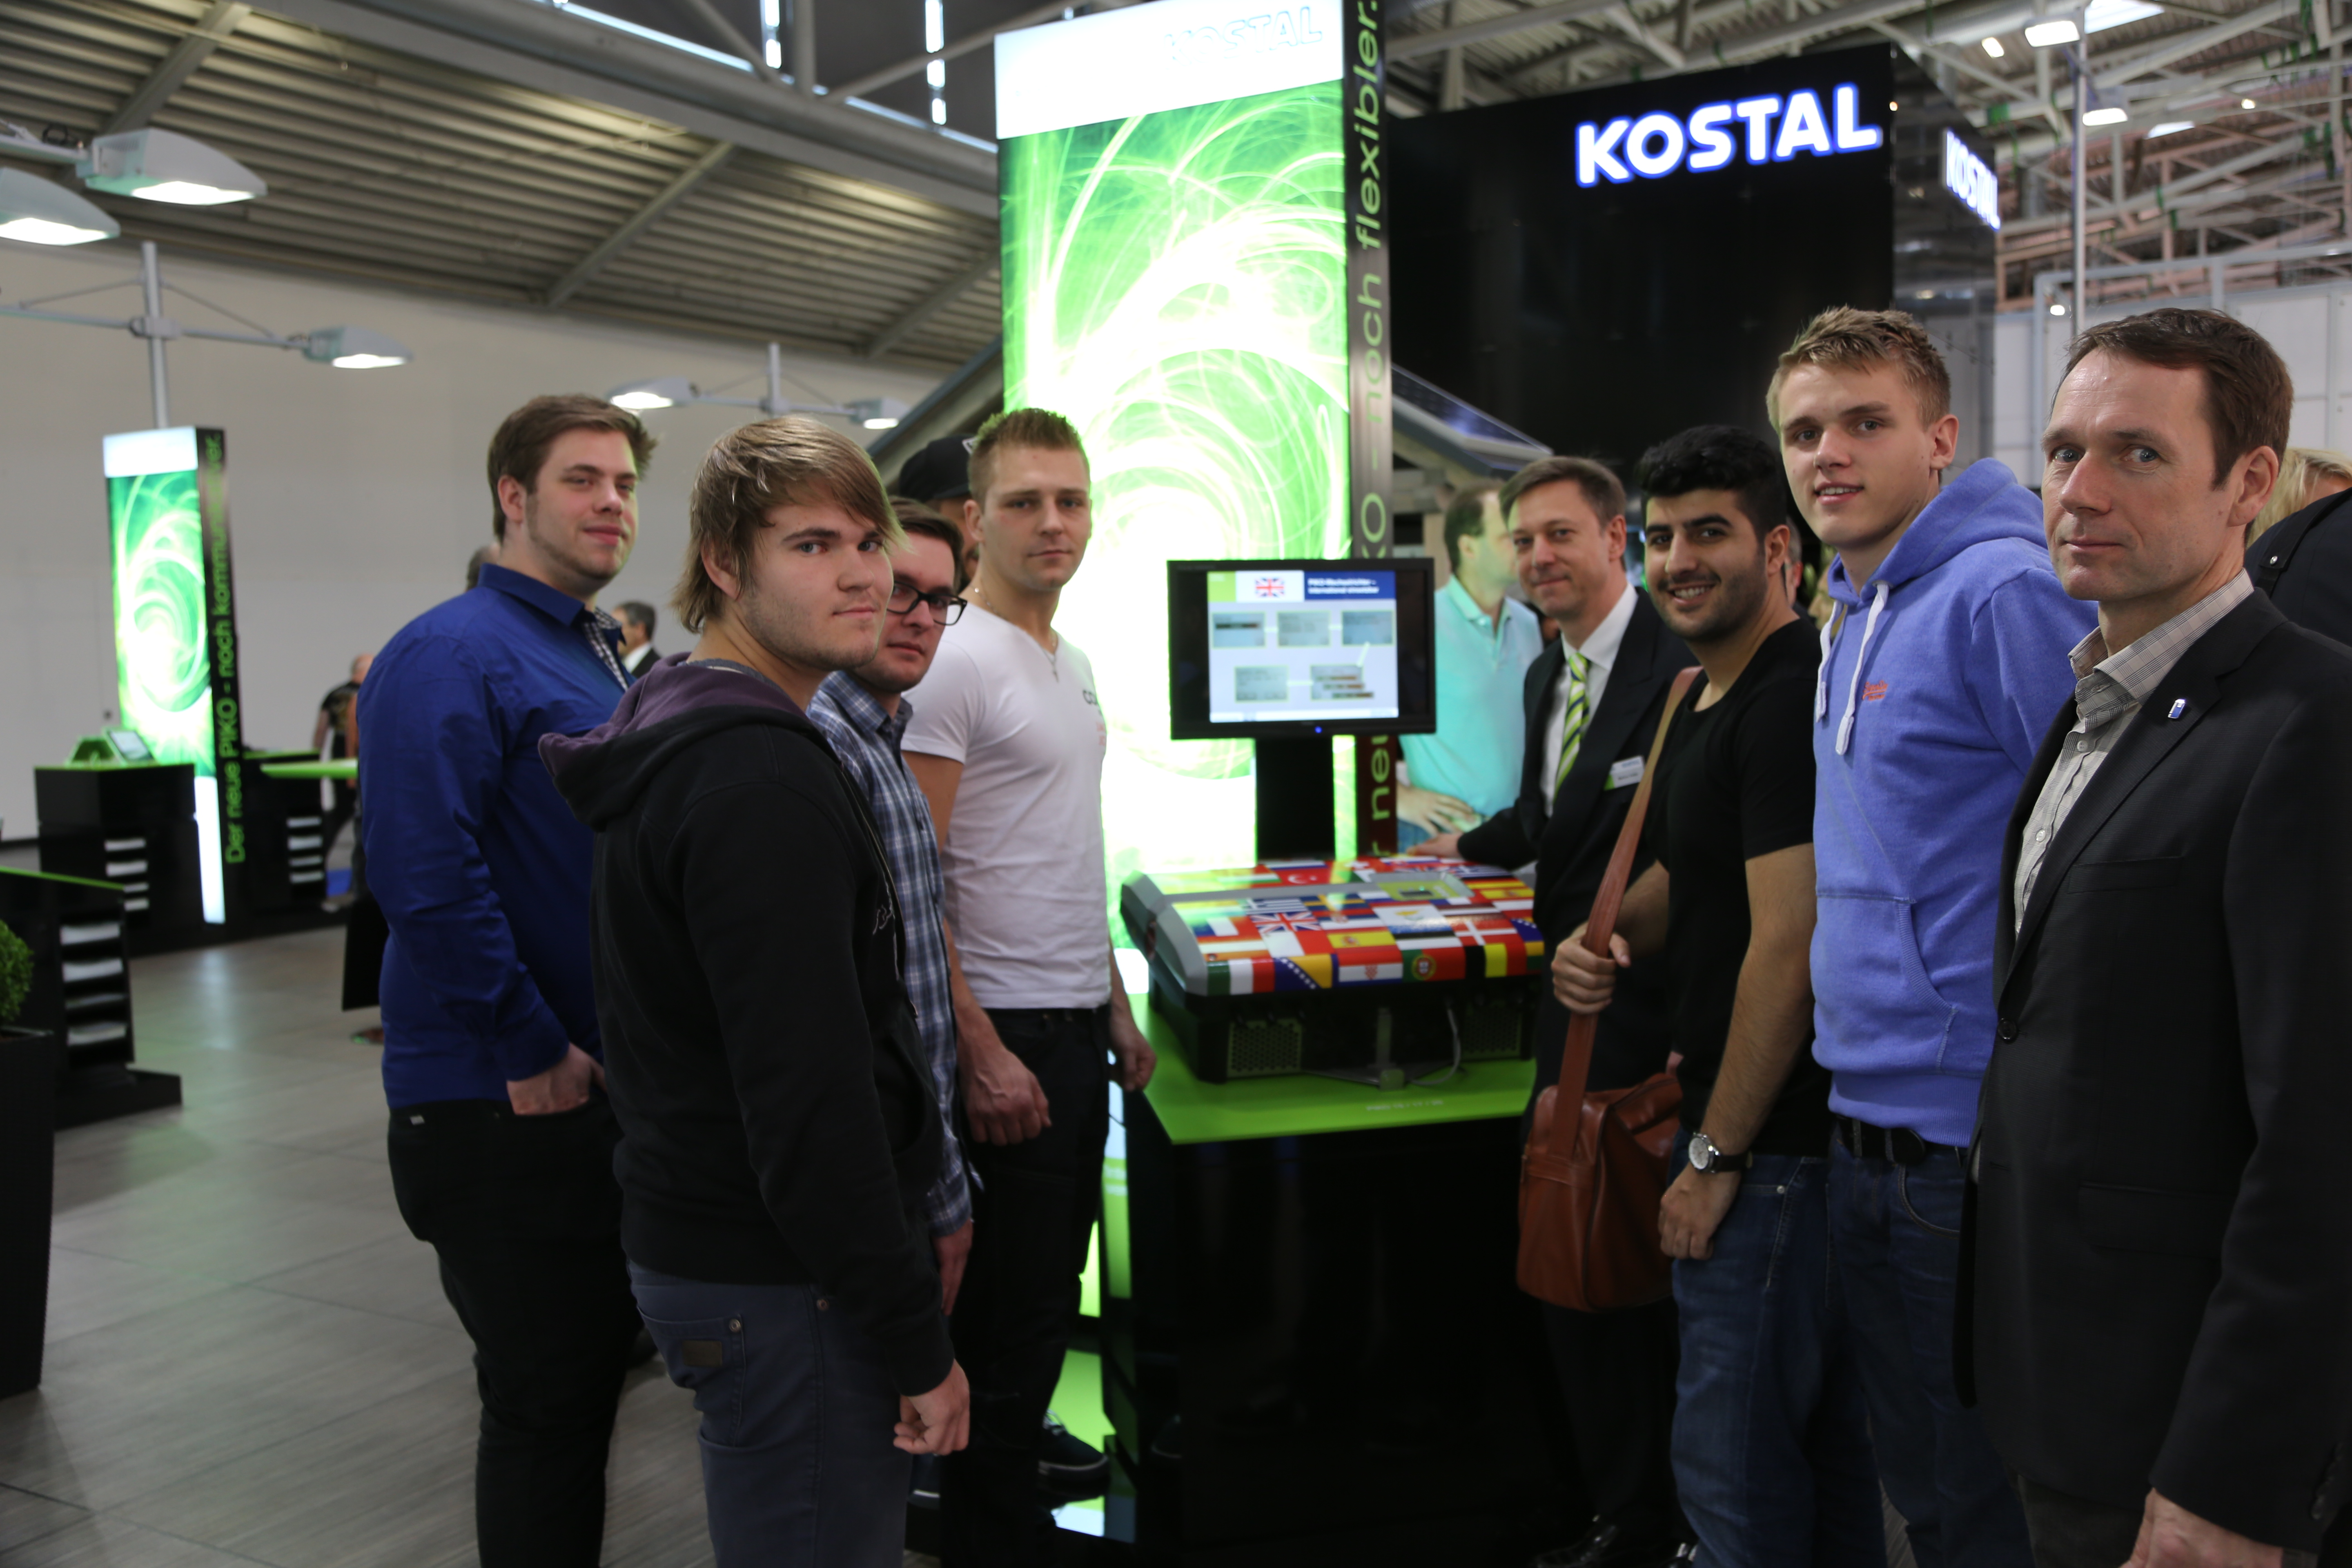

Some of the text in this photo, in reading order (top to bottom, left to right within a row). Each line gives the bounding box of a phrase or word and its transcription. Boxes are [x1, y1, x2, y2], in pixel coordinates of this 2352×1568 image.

[1164, 6, 1322, 68] KOSTAL
[1352, 1, 1381, 250] flexibler.
[1576, 83, 1882, 187] KOSTAL
[1946, 129, 2000, 230] KOSTAL
[1357, 273, 1383, 423] noch
[212, 619, 234, 677] noch
[216, 697, 237, 758] PIKO
[224, 761, 243, 818] neue
[225, 822, 245, 864] Der
